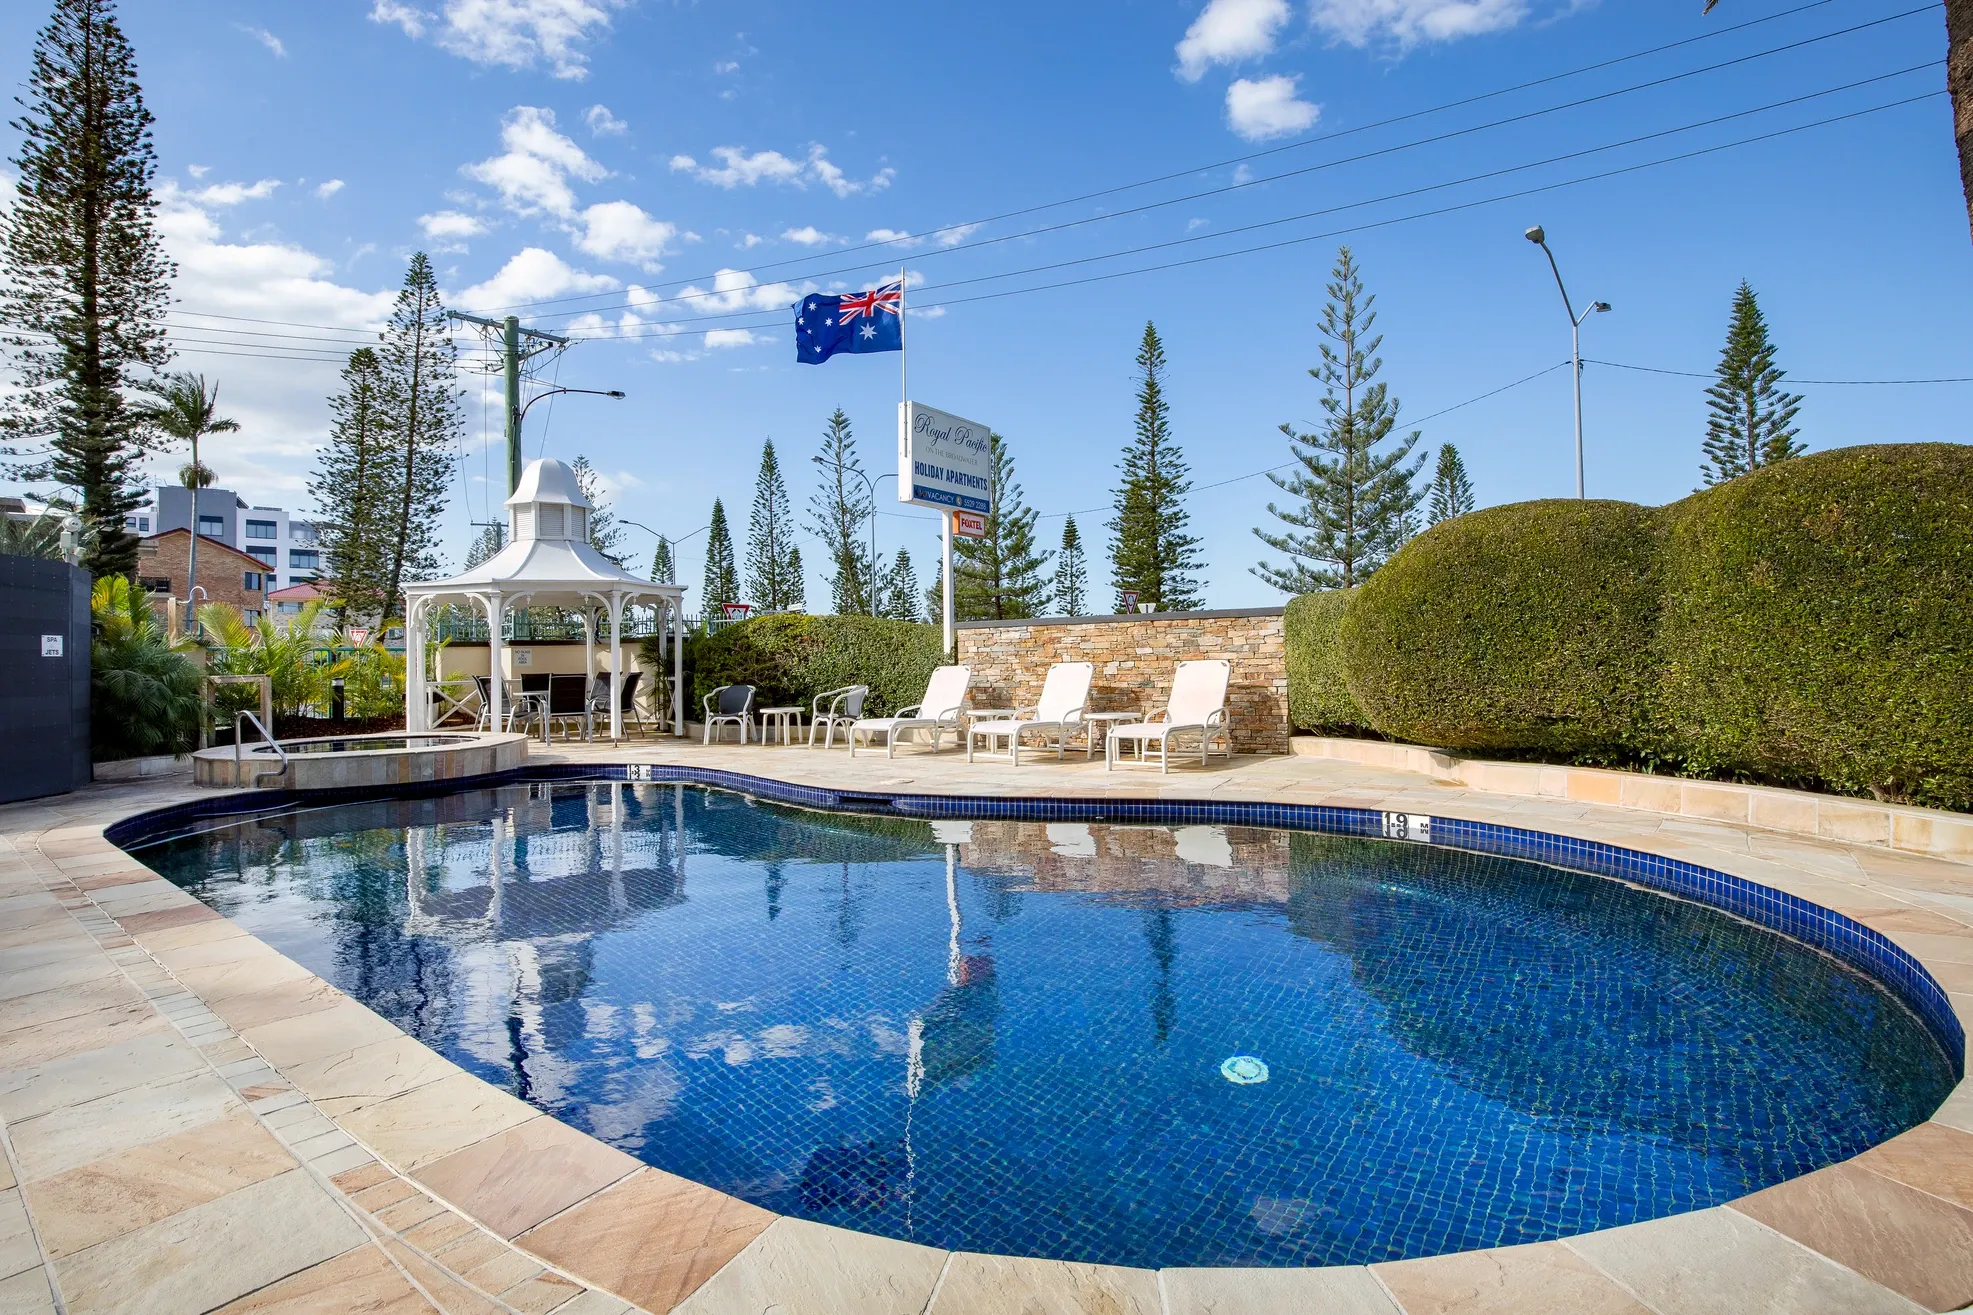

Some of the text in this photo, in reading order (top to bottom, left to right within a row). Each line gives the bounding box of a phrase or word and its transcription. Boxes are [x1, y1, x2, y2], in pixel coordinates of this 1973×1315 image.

[914, 413, 987, 456] Royal Pacific
[925, 446, 978, 465] ON THE BROADWATER
[914, 461, 987, 491] HOLIDAY APARTMENTS
[927, 491, 954, 503] VACANCY
[961, 518, 982, 530] FOXTEL
